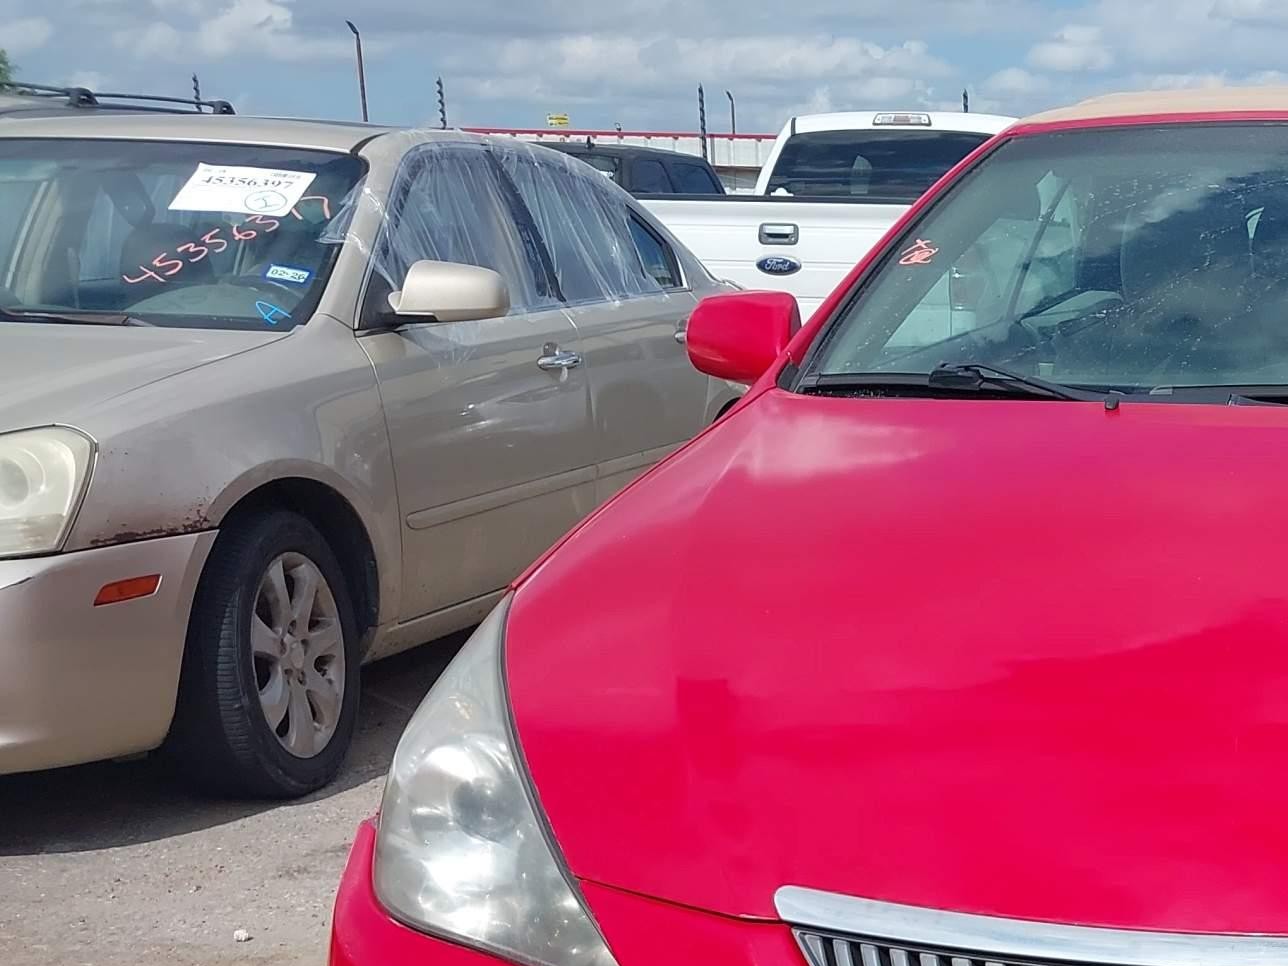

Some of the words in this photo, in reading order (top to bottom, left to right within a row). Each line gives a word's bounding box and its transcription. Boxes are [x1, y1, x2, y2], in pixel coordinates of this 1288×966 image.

[201, 175, 294, 190] 45356397
[122, 196, 330, 283] 4535637
[765, 258, 790, 271] Ford
